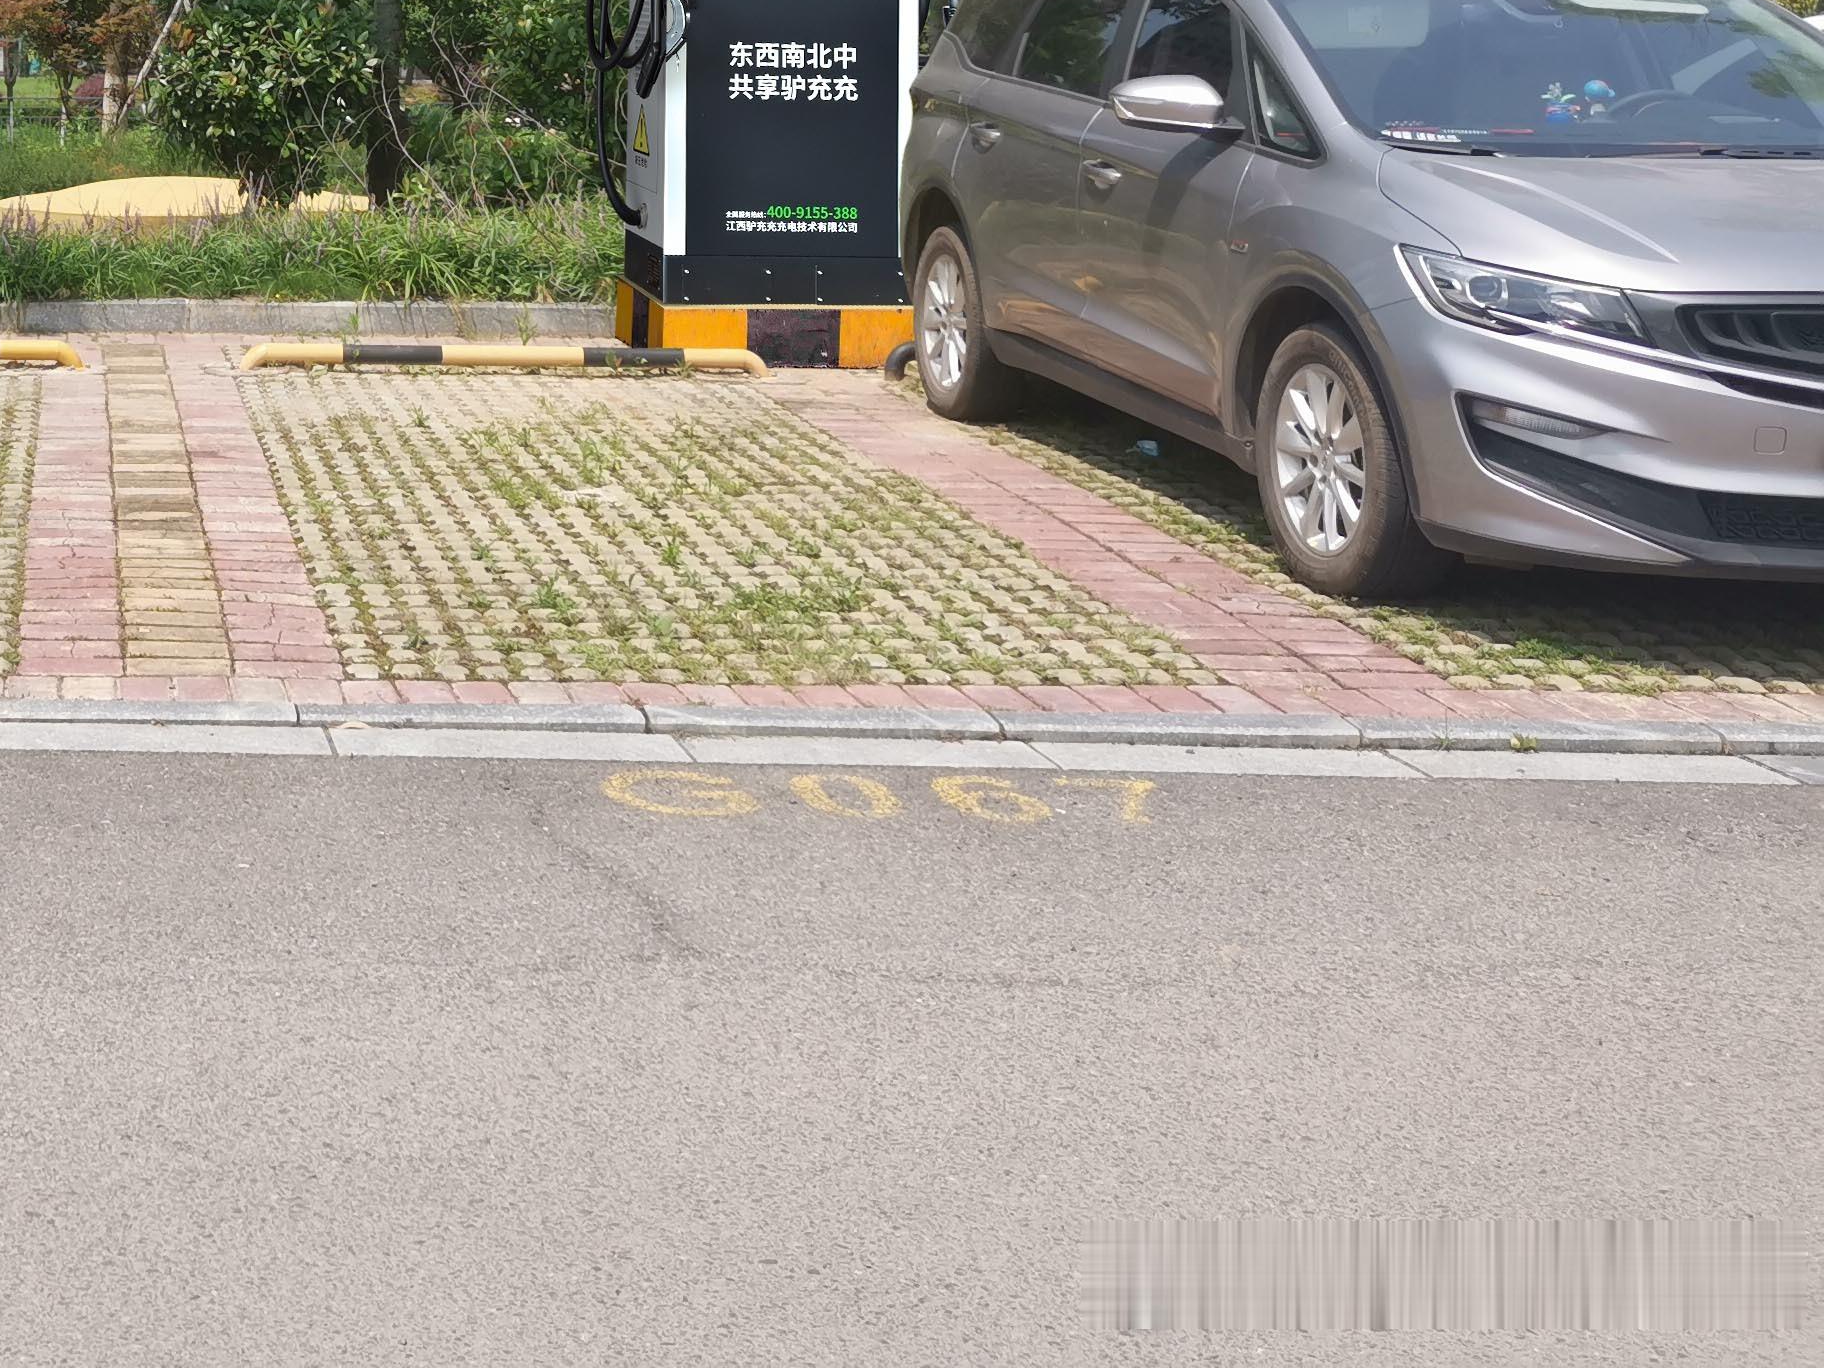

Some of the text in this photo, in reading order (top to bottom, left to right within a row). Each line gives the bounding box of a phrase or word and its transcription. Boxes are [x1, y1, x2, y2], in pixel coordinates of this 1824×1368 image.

[729, 41, 857, 70] 东西南北中
[728, 73, 859, 102] 共享驴充充
[725, 220, 858, 233] 江西驴充充充电技术有限公司
[767, 205, 858, 220] 400-9155-388
[599, 768, 1157, 824] G067
